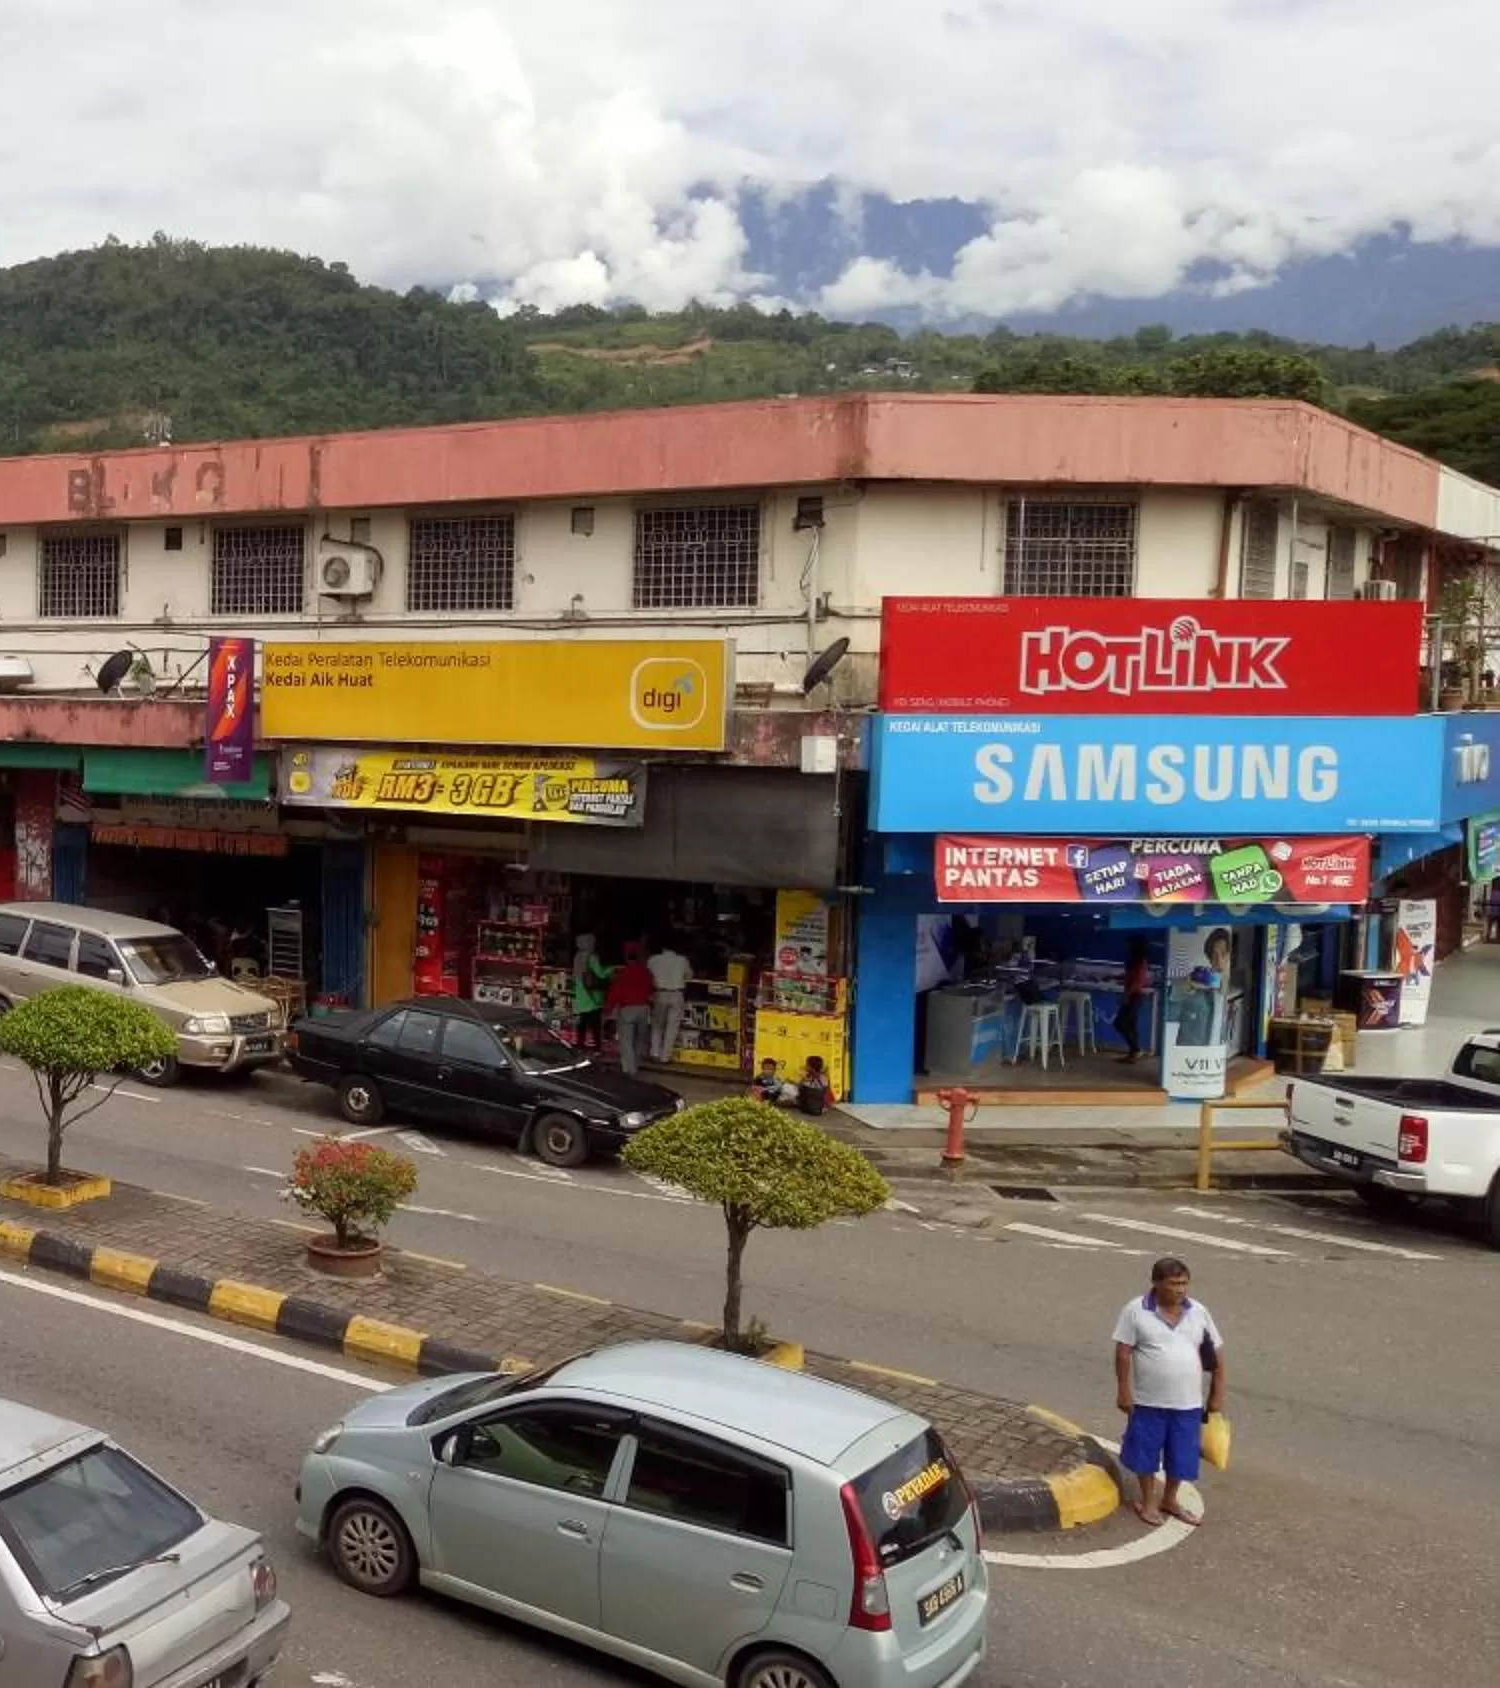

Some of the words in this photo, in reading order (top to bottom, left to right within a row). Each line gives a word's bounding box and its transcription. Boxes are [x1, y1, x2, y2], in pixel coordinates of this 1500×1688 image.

[265, 652, 303, 667] Kedai
[308, 652, 373, 667] Peralatan
[377, 652, 492, 668] Telekomunikasi
[1019, 615, 1292, 696] HOTLINK
[227, 655, 237, 719] XPAX
[265, 672, 305, 687] Kedai
[310, 673, 333, 687] Aik
[338, 673, 374, 687] Huat
[643, 688, 681, 713] digi
[888, 720, 922, 733] KEDAI
[951, 720, 1041, 733] TELEKOMUNIKASI
[973, 743, 1340, 805] SAMSUNG
[944, 847, 1059, 866] INTERNET
[1130, 840, 1222, 856] PERCUMA
[944, 868, 1041, 887] PANTAS
[1085, 861, 1128, 885] SETIAP
[1155, 863, 1194, 883] TIADA
[1221, 863, 1264, 884] TANPA
[1095, 878, 1126, 895] HARI
[1153, 873, 1202, 897] BATASAN
[1230, 878, 1258, 896] HAD
